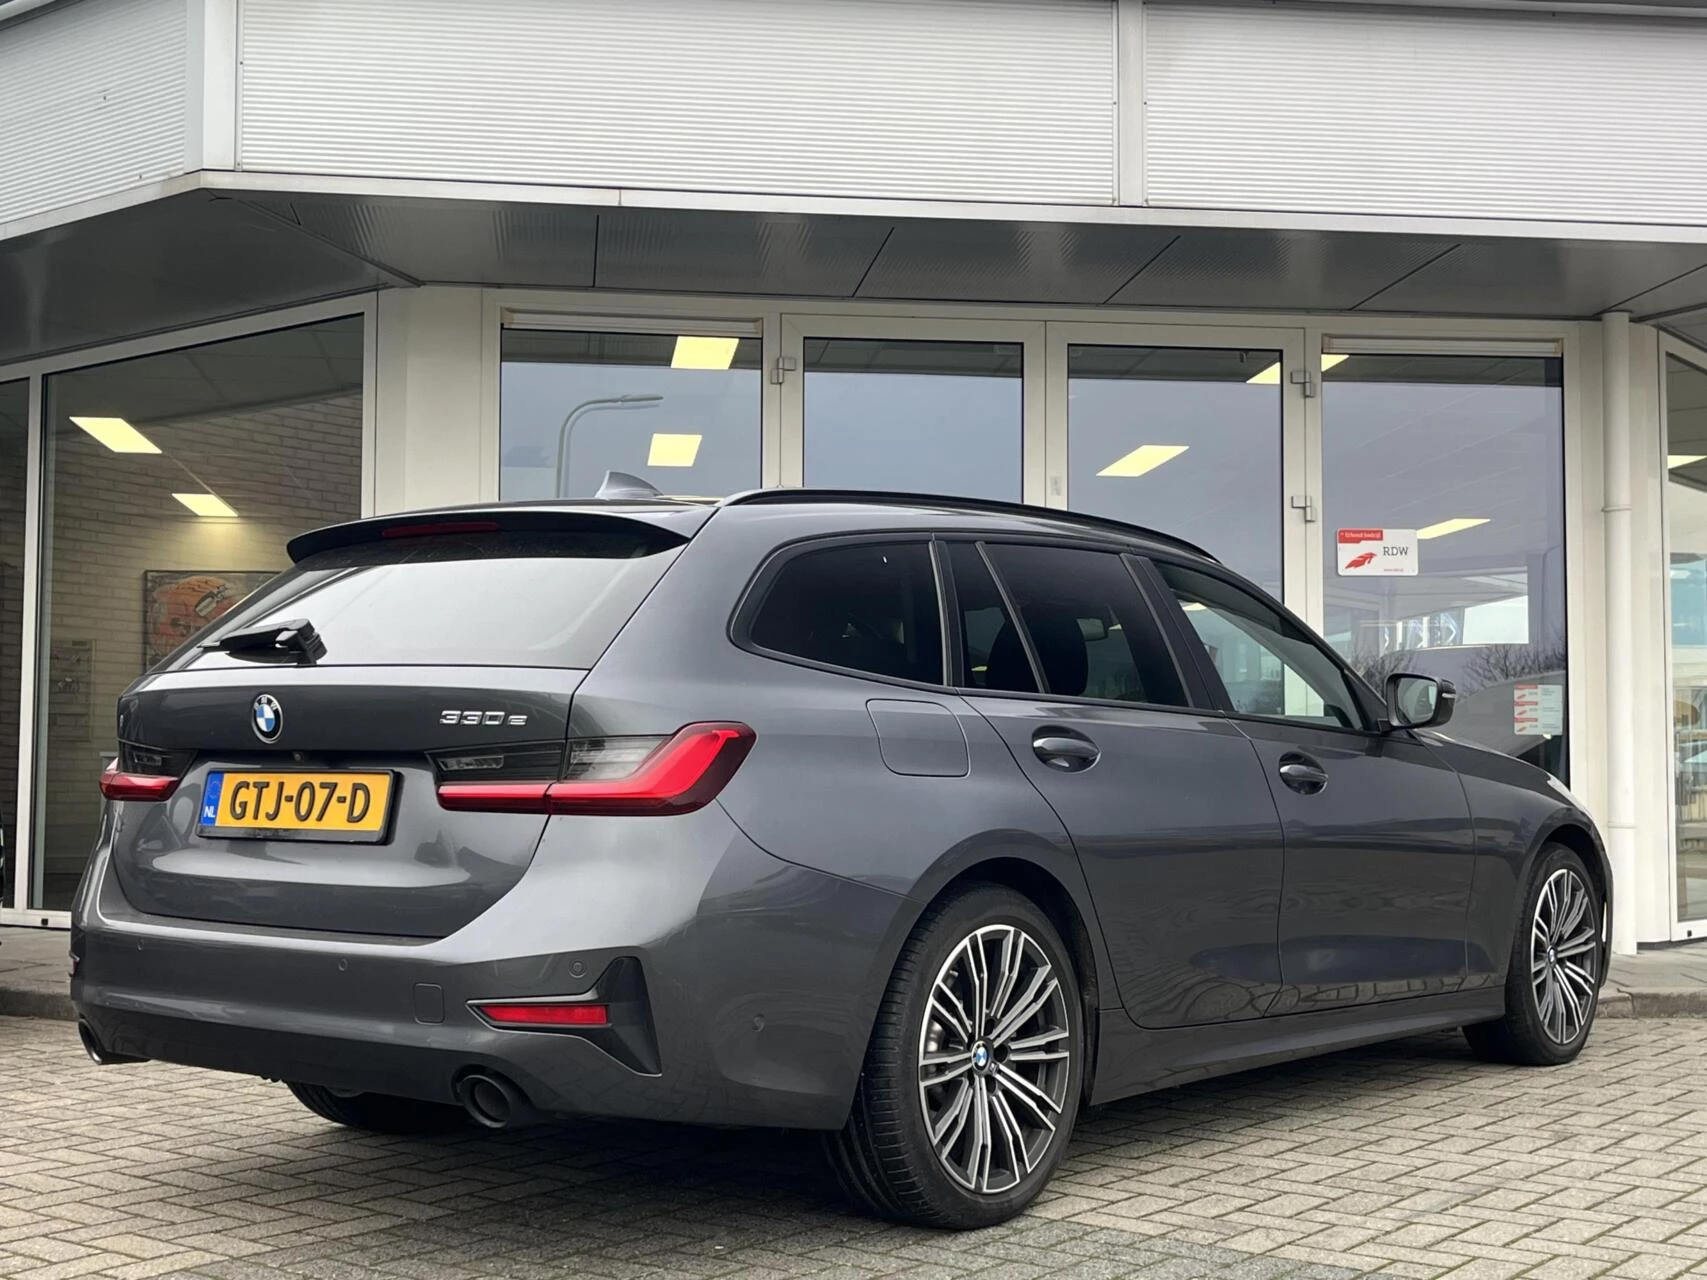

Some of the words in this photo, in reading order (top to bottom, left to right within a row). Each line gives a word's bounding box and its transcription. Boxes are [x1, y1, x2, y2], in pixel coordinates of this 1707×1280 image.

[1383, 546, 1408, 556] RDW
[440, 710, 528, 726] 330e
[229, 780, 371, 823] GTJ-07-D
[204, 805, 216, 818] NL
